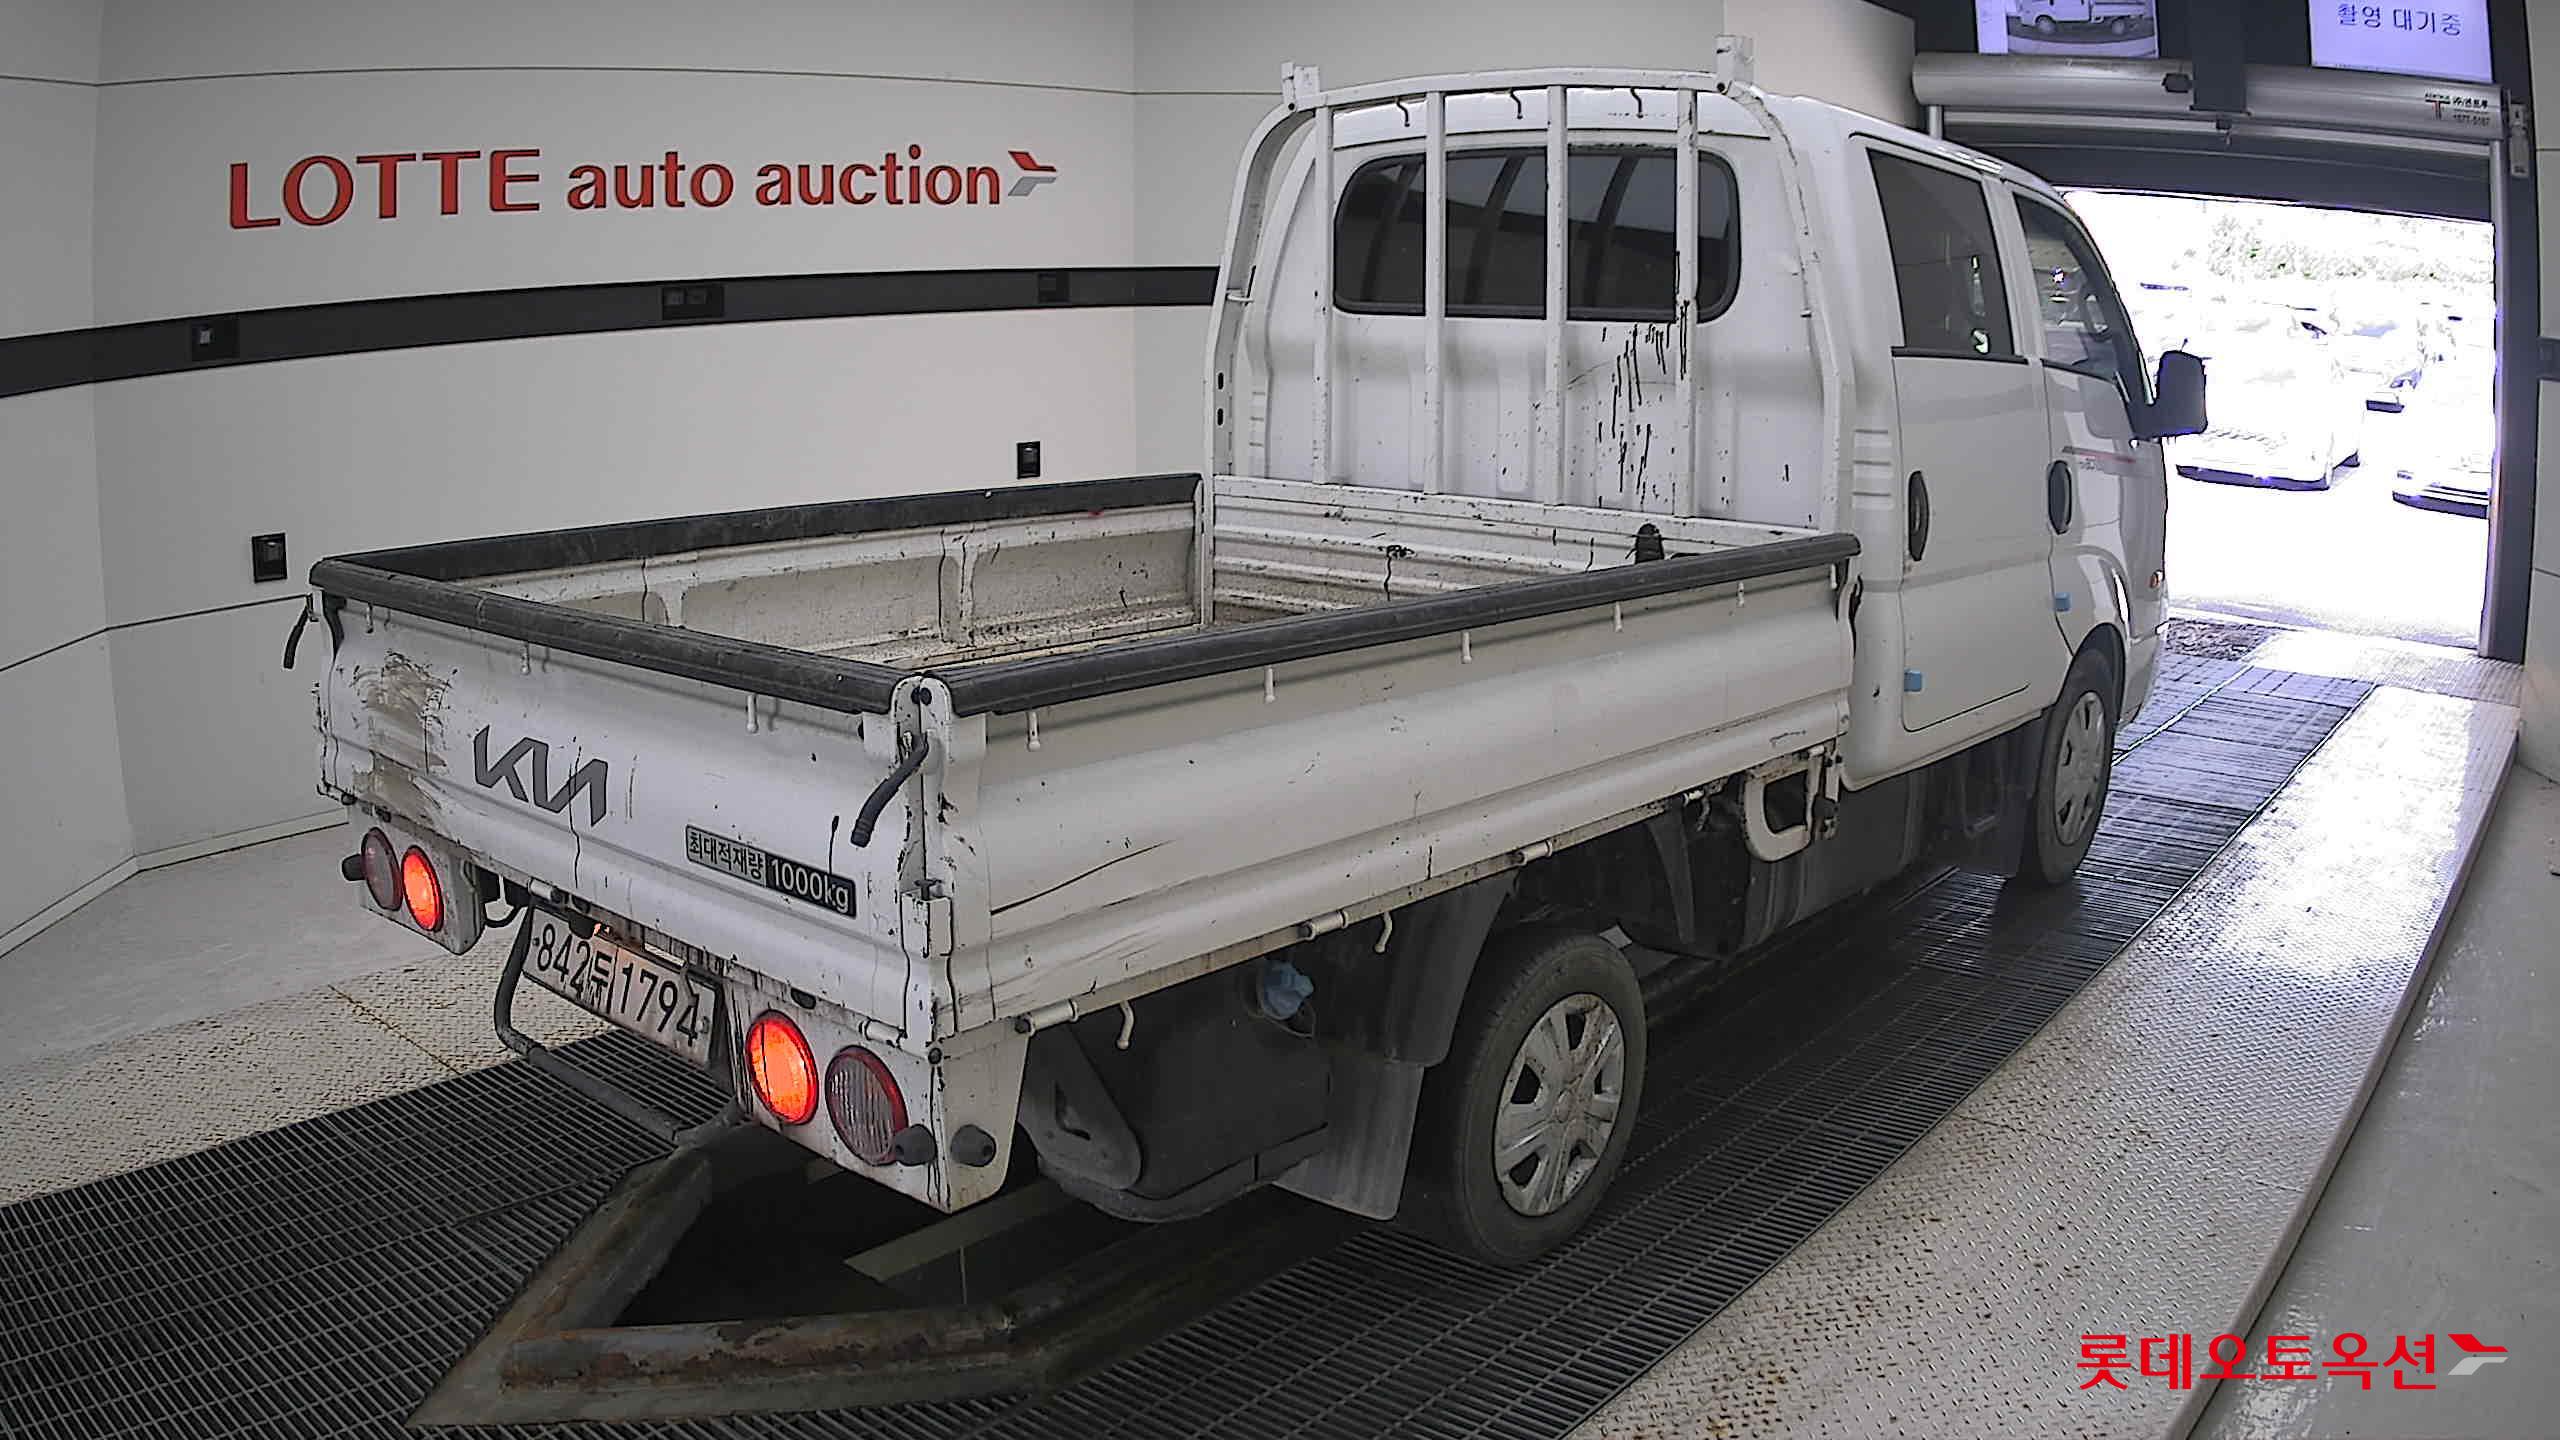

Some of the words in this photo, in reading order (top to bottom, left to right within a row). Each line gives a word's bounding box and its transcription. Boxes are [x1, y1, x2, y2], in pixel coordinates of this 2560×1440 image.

[2338, 3, 2381, 28] 촬영
[2392, 8, 2461, 36] 대기중
[230, 150, 537, 229] LOTTE
[568, 153, 734, 209] auto
[757, 146, 1001, 206] auction
[474, 725, 608, 827] KIA
[688, 831, 764, 881] 최대적재량
[770, 858, 850, 914] 1000kg
